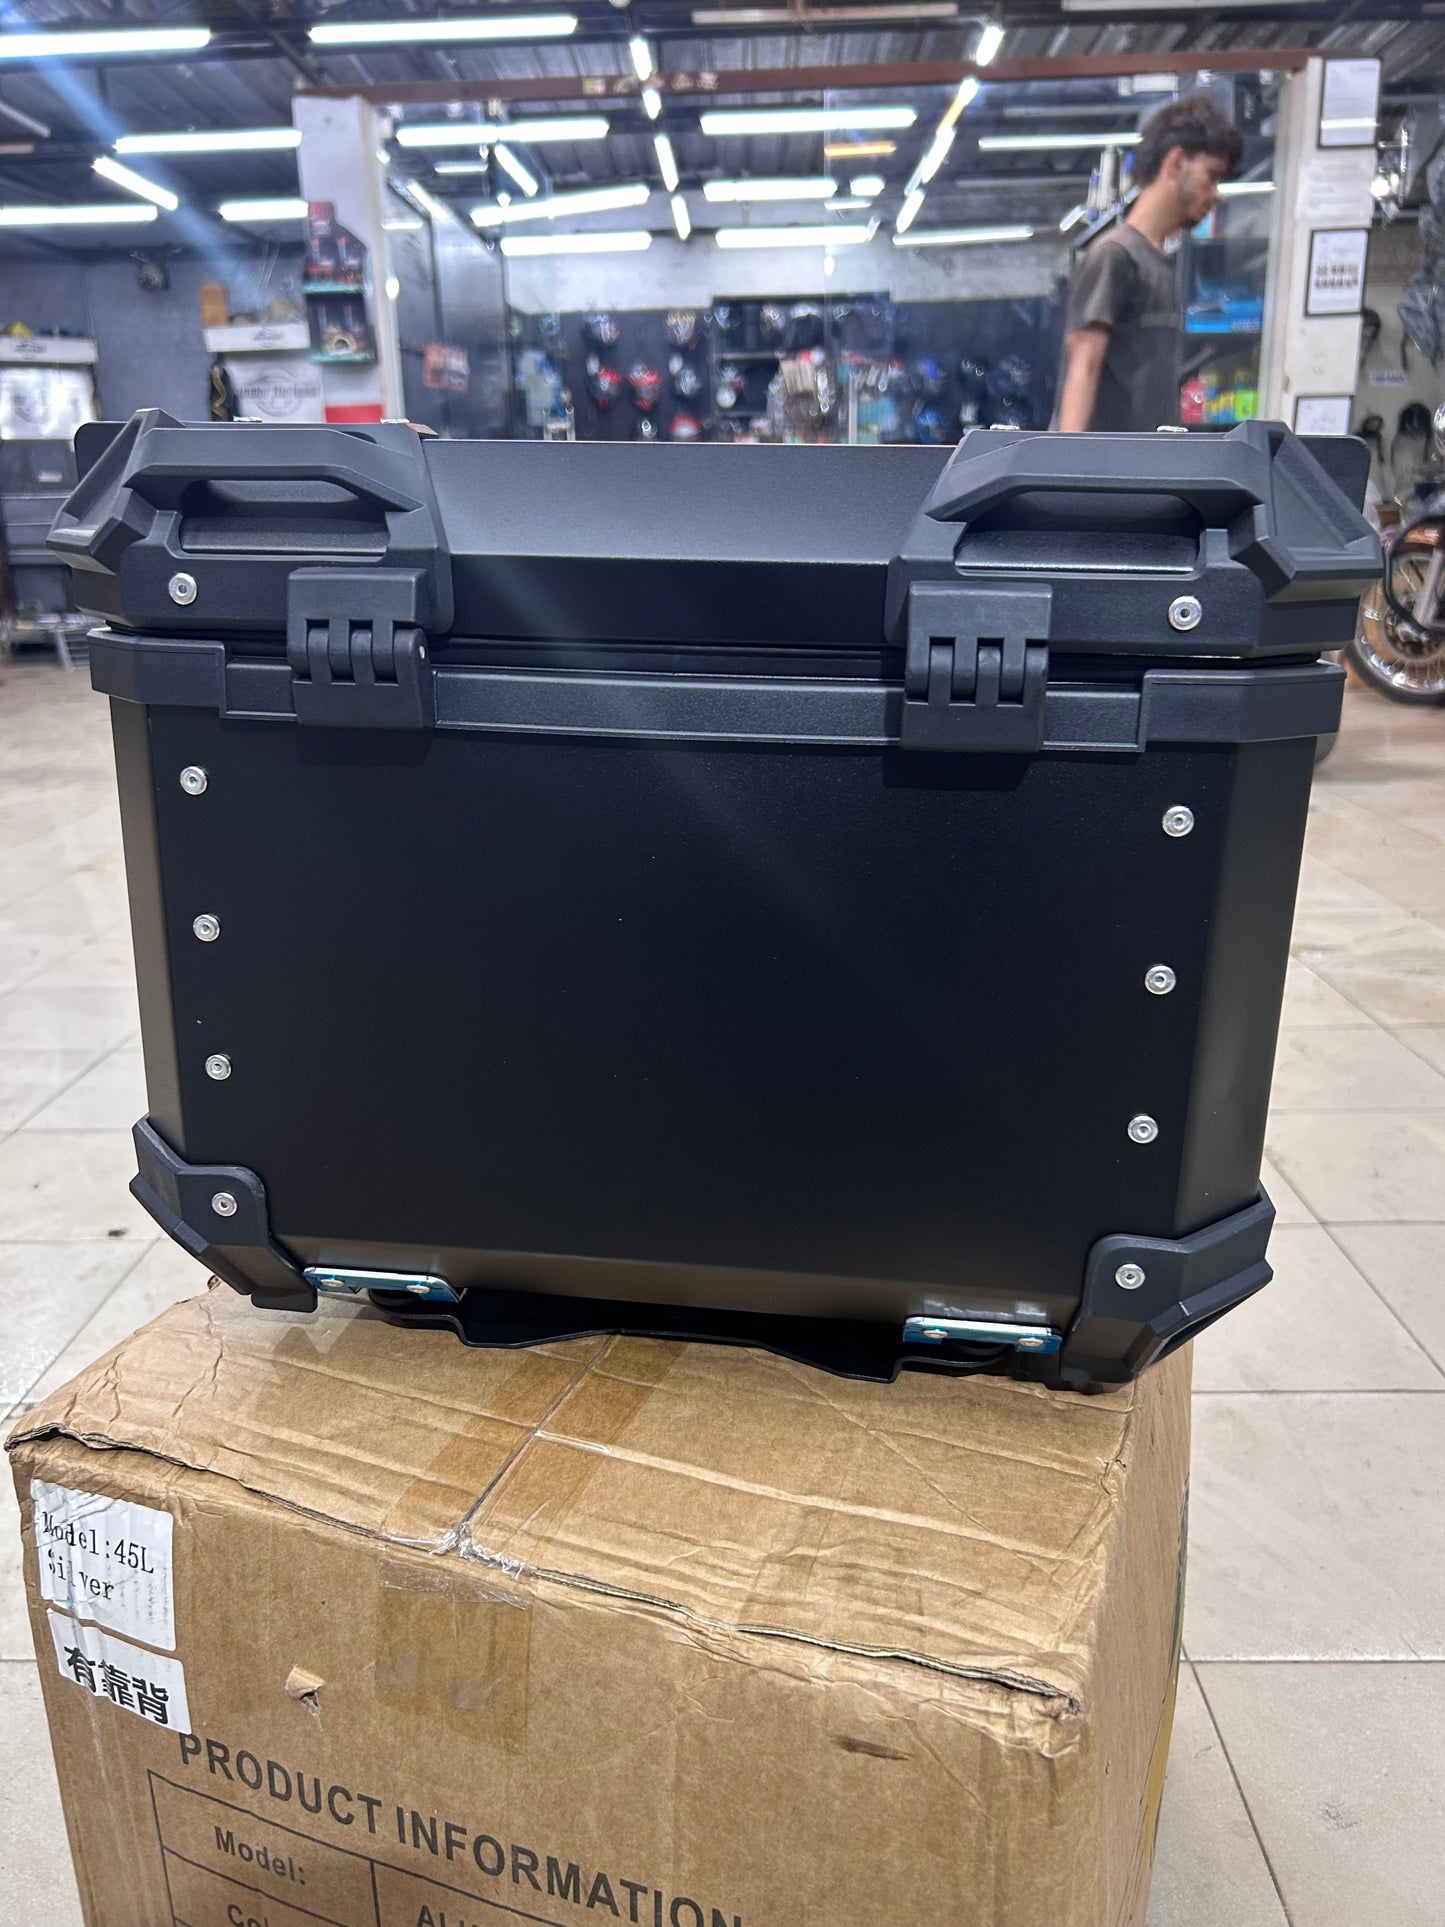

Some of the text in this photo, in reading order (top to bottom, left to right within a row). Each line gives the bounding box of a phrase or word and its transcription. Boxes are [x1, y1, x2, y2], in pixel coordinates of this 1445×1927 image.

[42, 1511, 154, 1574] Model:45L
[47, 1548, 115, 1600] Silver
[64, 1646, 169, 1724] 有靠背
[179, 1732, 382, 1834] PRODUCT
[214, 1825, 306, 1885] Model:
